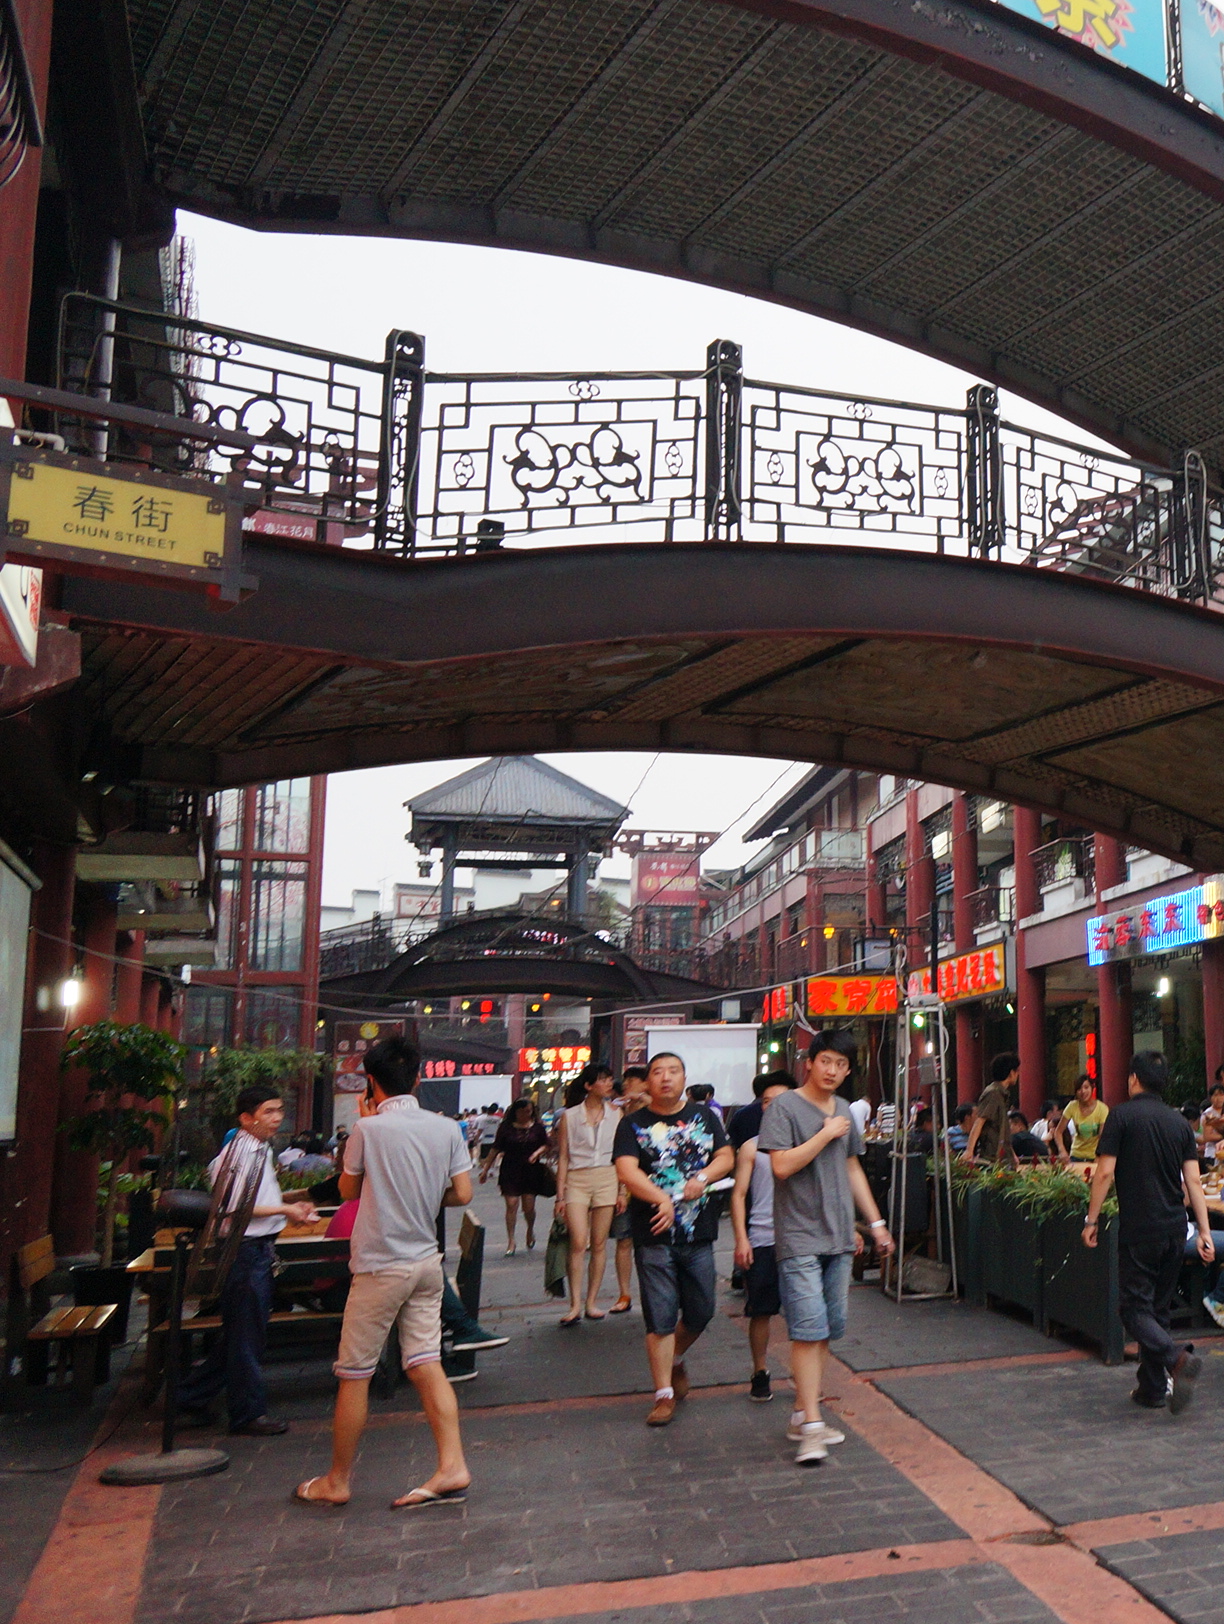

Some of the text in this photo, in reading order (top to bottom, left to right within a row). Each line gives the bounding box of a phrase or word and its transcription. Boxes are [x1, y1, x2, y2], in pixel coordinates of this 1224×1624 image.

[73, 485, 174, 533] 春街
[63, 521, 178, 551] CHUN STREET
[807, 979, 898, 1014] 家常菜
